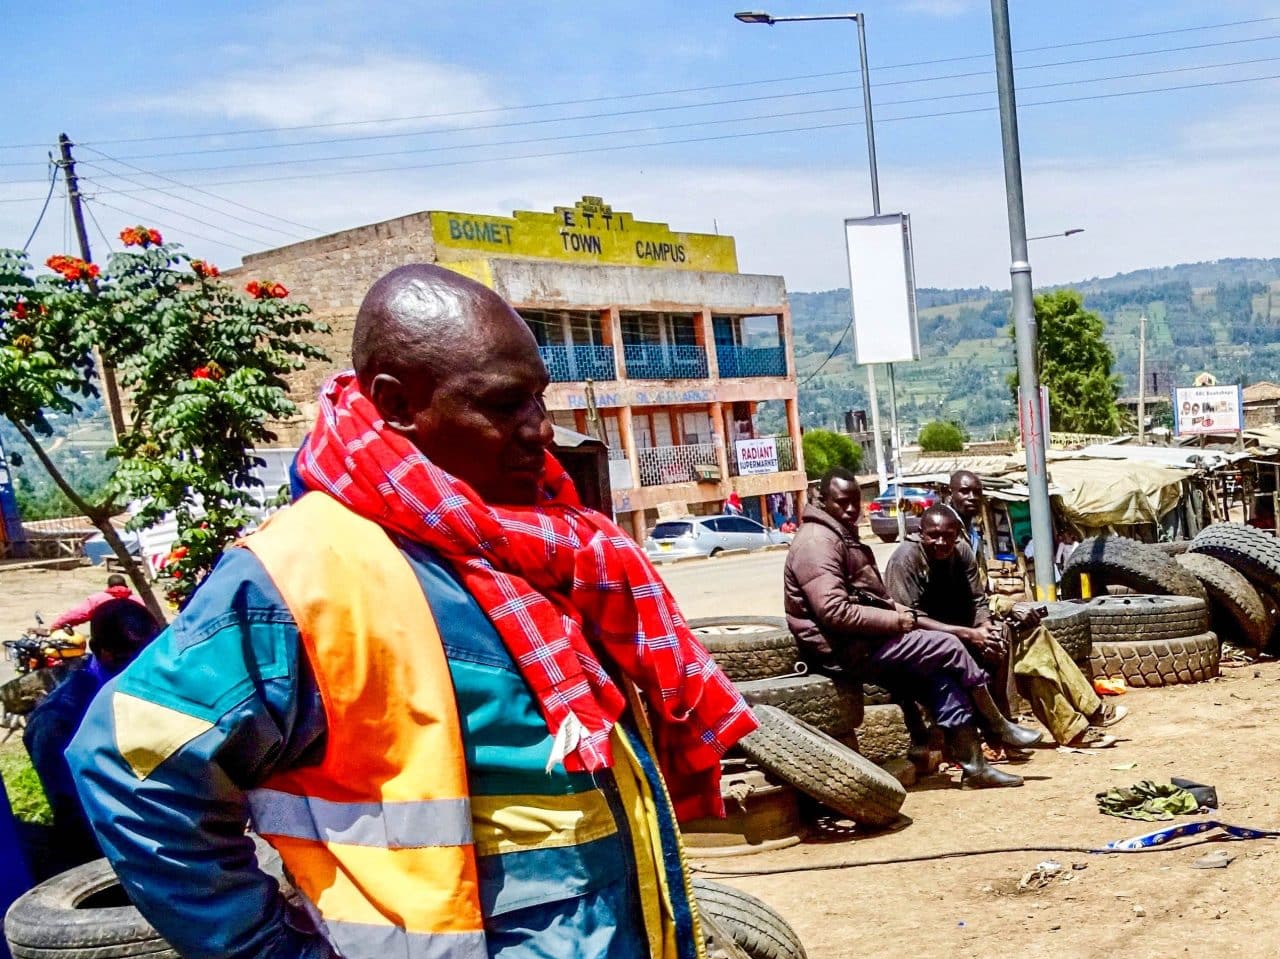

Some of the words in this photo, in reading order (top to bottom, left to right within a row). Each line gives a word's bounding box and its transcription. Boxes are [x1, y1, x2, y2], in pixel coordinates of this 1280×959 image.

[450, 219, 513, 245] BOMET
[560, 231, 602, 254] TOWN
[635, 240, 686, 263] CAMPUS
[741, 446, 773, 461] RADIANT
